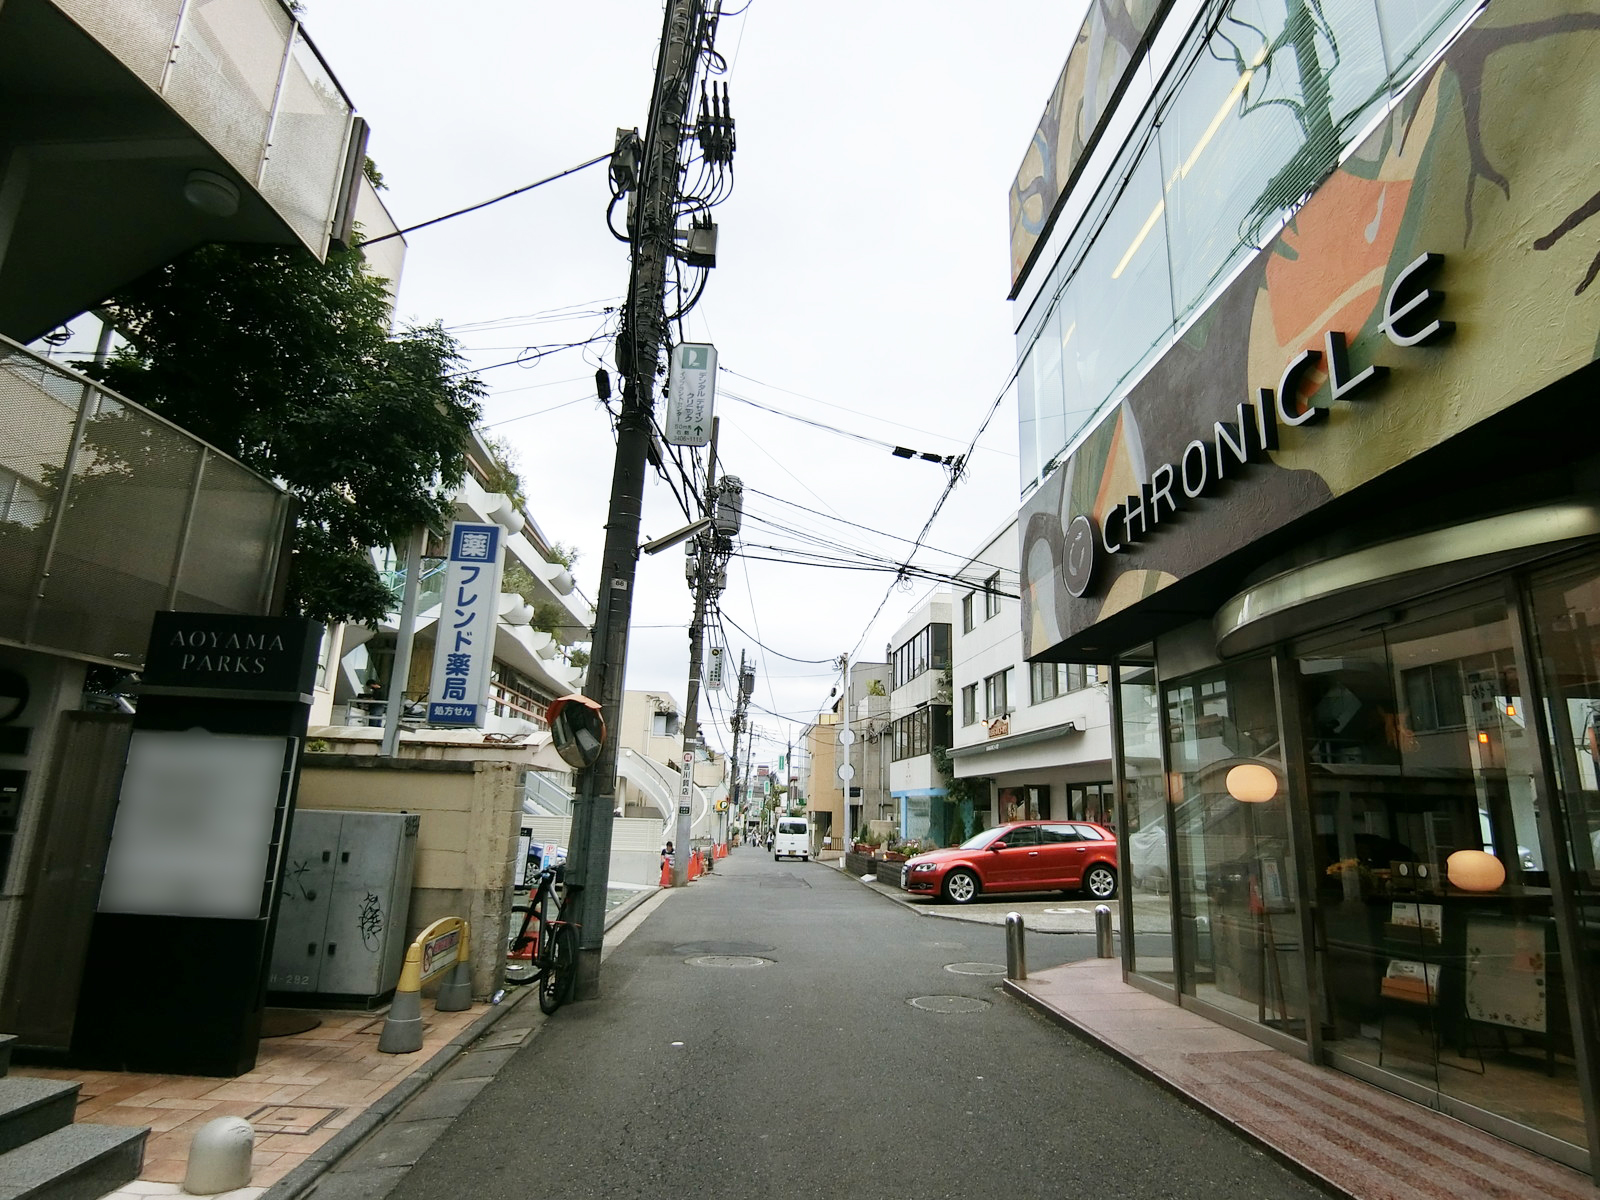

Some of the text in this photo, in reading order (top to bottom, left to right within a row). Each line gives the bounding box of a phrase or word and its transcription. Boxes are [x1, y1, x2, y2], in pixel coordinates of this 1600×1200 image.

[684, 393, 695, 423] クリニック
[1101, 251, 1456, 556] CHRONICLE
[462, 533, 488, 557] 薬
[170, 630, 284, 651] AOYAMA
[442, 565, 481, 701] フレンド薬局
[182, 653, 267, 674] PARKS
[434, 705, 473, 718] 処方せん
